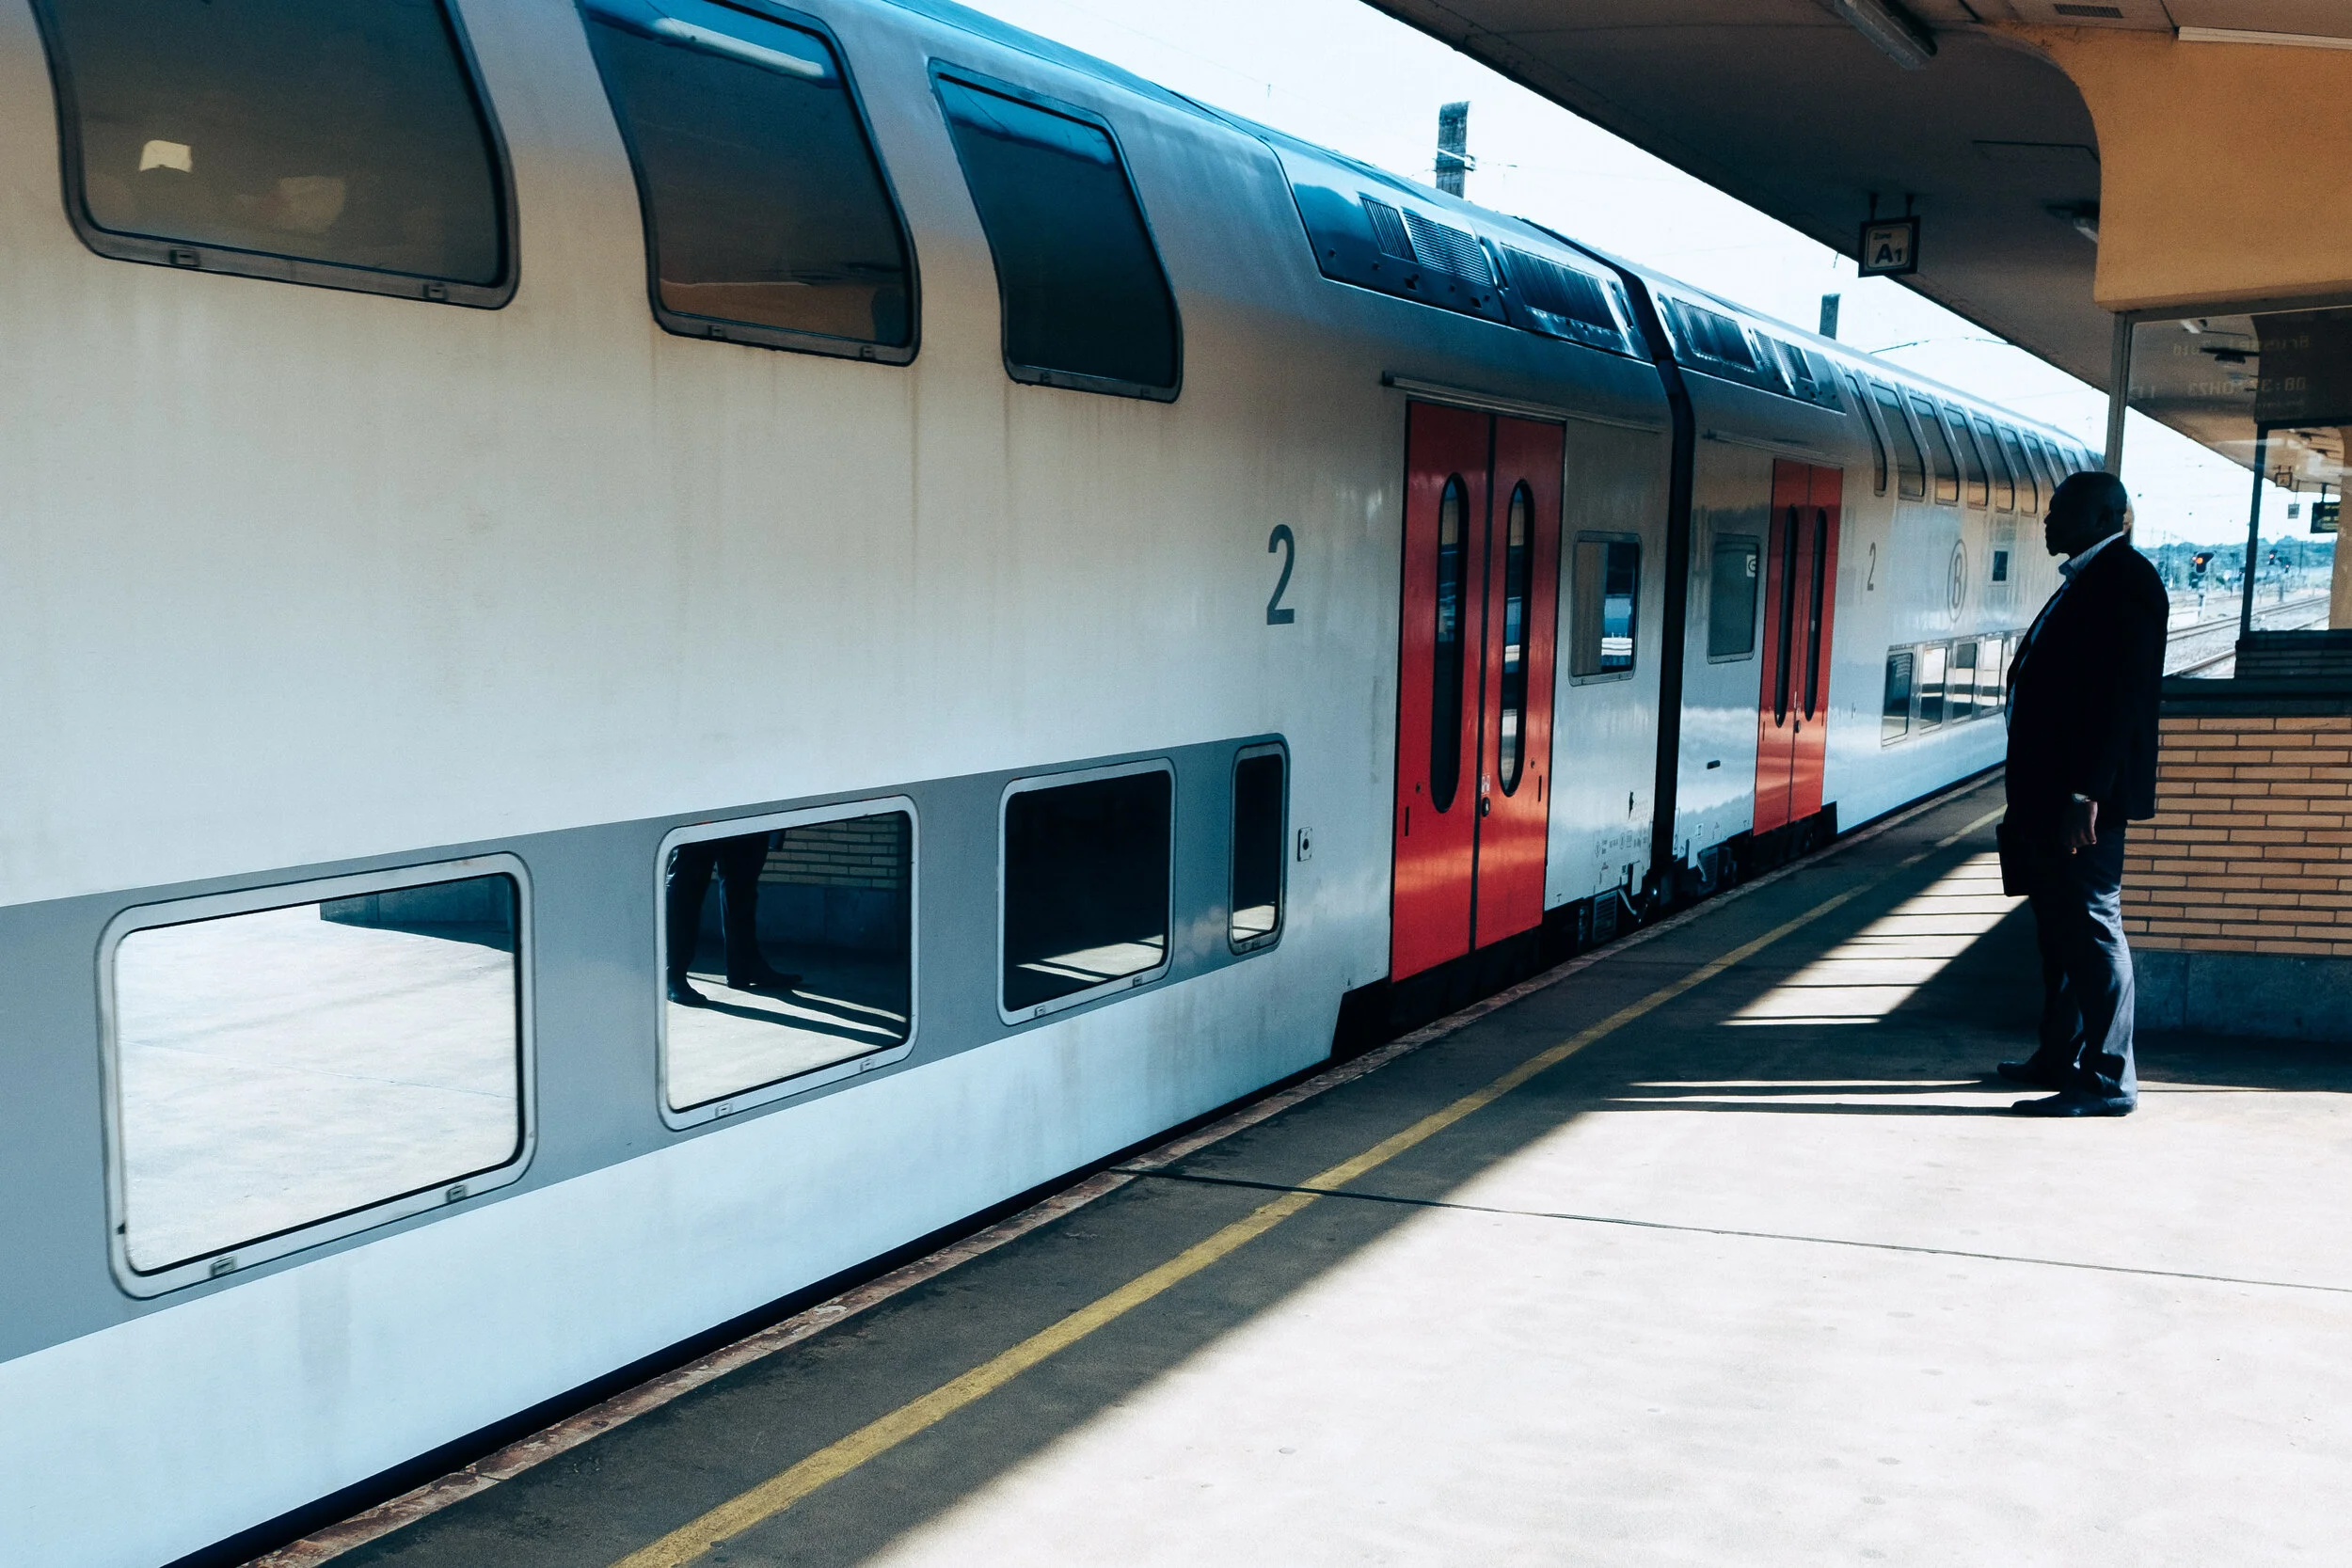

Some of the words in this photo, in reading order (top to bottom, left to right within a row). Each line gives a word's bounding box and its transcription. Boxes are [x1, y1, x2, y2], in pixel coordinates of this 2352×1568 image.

[1875, 244, 1902, 263] A1
[1266, 524, 1295, 626] 2
[1867, 542, 1876, 591] 2
